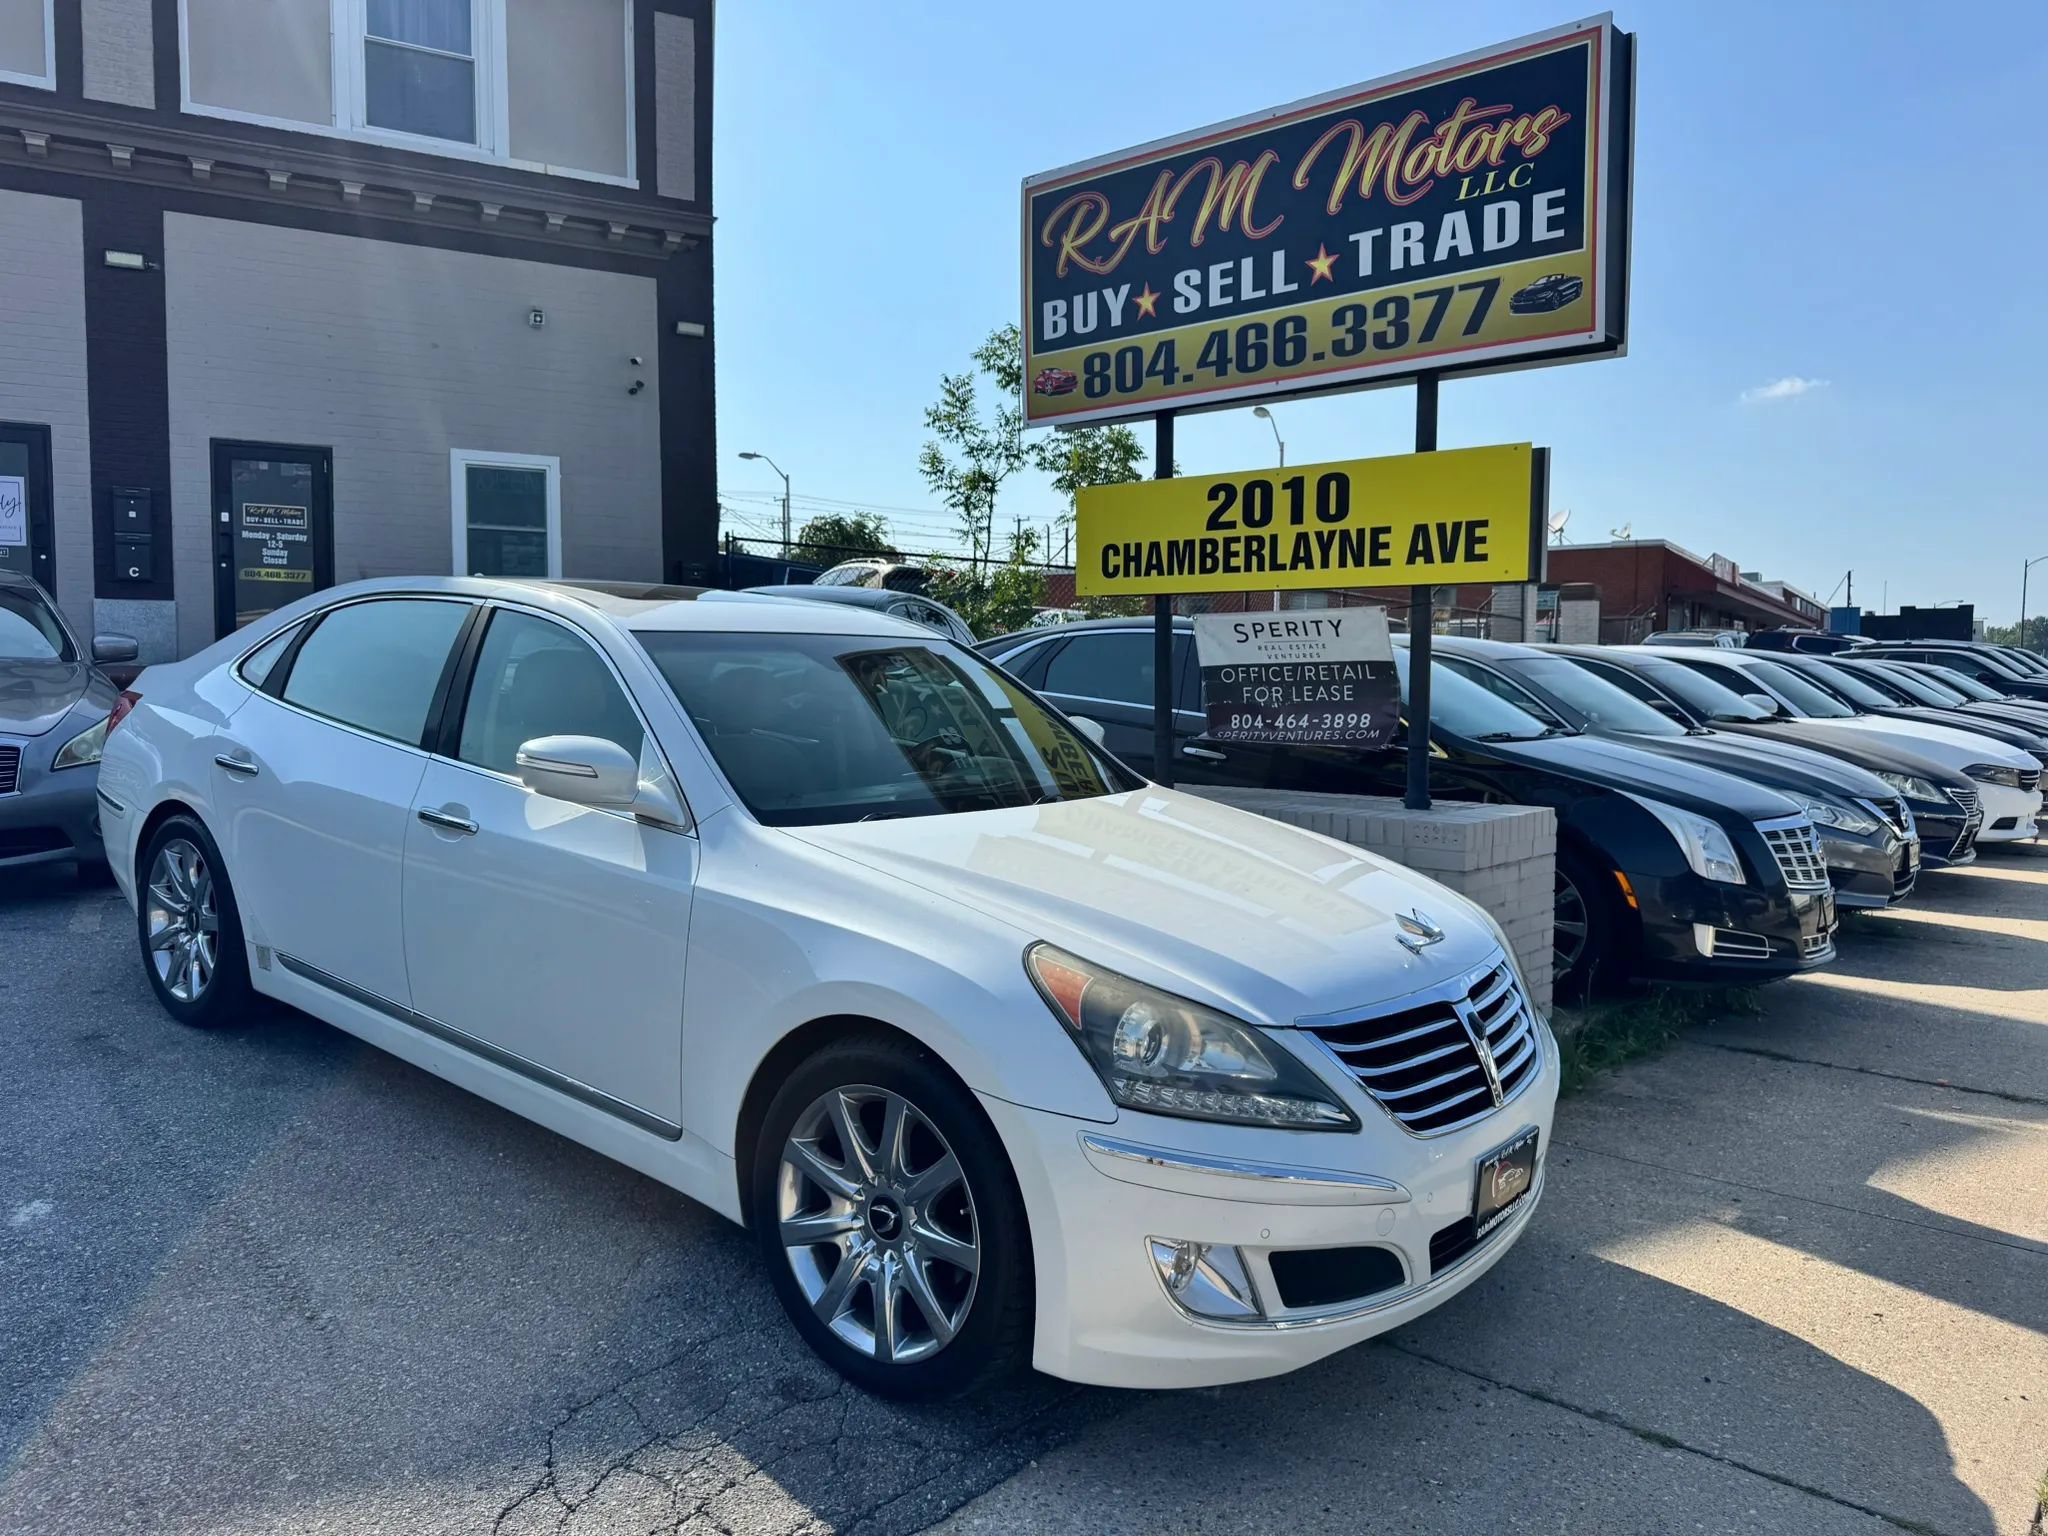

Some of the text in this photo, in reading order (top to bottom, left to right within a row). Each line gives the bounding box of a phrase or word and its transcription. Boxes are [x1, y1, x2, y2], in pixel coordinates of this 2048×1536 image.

[1041, 97, 1571, 278] RAM Motors
[1455, 162, 1535, 201] LLC
[1043, 188, 1566, 341] BUY SELL TRADE
[1082, 277, 1502, 400] 804.466.3377
[1205, 472, 1350, 531] 2010
[241, 530, 270, 540] Monday
[276, 532, 308, 542] Saturday
[267, 540, 284, 548] 12-5
[262, 548, 288, 557] Sunday
[1101, 520, 1489, 579] CHAMBERLAYNE AVE
[263, 556, 287, 565] Closed
[129, 566, 140, 577] C
[1233, 619, 1342, 643] SPERITY
[1257, 642, 1327, 651] REAL ESTATE
[1267, 652, 1321, 660] VENTURES
[1220, 664, 1376, 683] OFFICE/RETAIL
[1243, 685, 1354, 703] FOR LEASE
[1230, 713, 1372, 729] 804-464-3898
[1216, 729, 1379, 741] SPERITYVENTURES.COM
